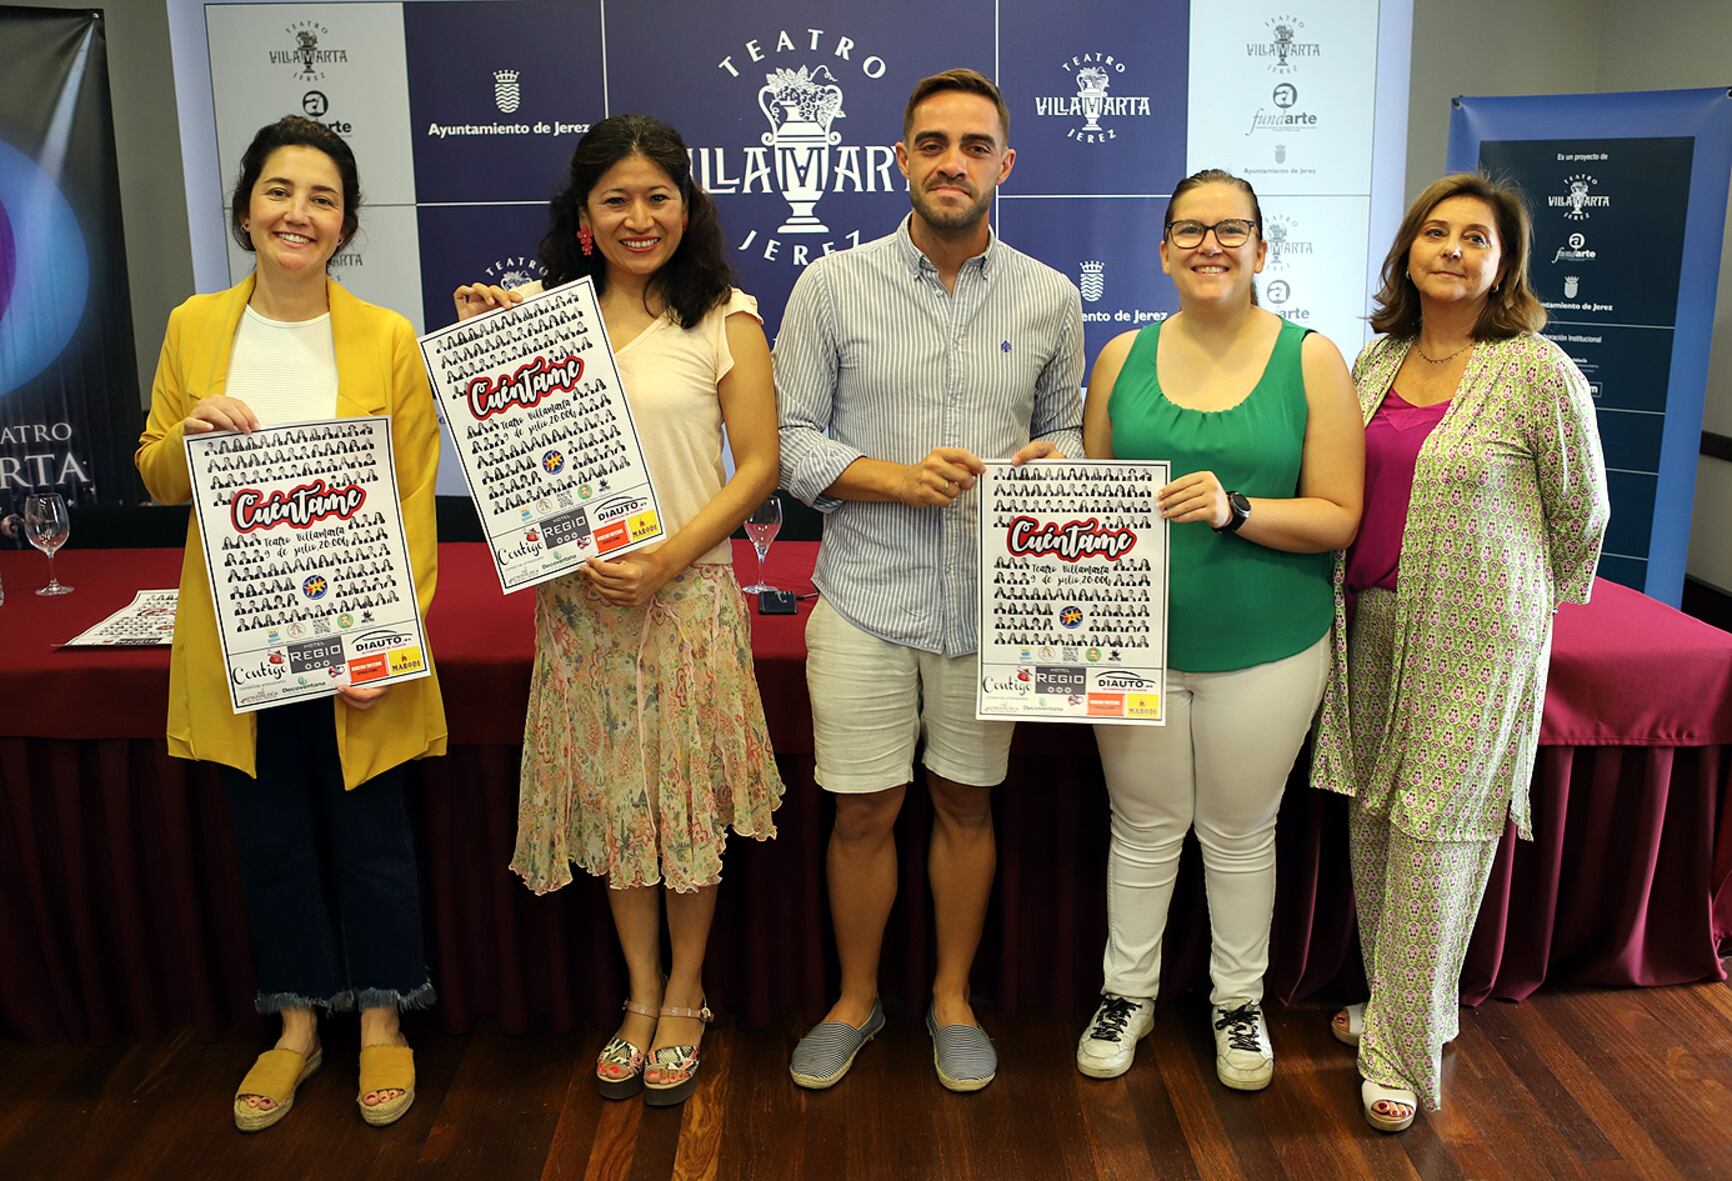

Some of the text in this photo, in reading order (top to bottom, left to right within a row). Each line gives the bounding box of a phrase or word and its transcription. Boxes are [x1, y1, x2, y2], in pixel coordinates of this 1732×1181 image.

[269, 49, 348, 64] VILLAMARTA
[718, 28, 886, 79] TEATRO
[1246, 43, 1320, 56] VILLAMARTA
[1061, 52, 1126, 73] TEATRO
[1035, 96, 1151, 116] VILLAMARTA
[328, 120, 352, 134] rte
[428, 121, 590, 139] Ayuntamiento de Jerez
[1245, 107, 1318, 136] fundarte
[1066, 128, 1117, 144] JEREZ
[1574, 153, 1600, 162] proyecto
[686, 144, 911, 194] LLAMAR
[333, 253, 364, 267] ARTA
[1279, 307, 1311, 320] arte
[1541, 301, 1614, 312] ntamiento de Jerez
[1081, 309, 1168, 324] ento de Jerez
[468, 357, 583, 420] Cuéntame
[500, 416, 524, 431] Teatro
[0, 422, 72, 445] ATRO
[513, 428, 524, 439] de
[0, 451, 91, 490] RTA
[232, 480, 365, 533] Cuéntame
[541, 517, 587, 538] REGIO
[263, 537, 291, 549] Teatro
[1008, 516, 1136, 561] Cuéntame
[277, 547, 288, 558] de
[497, 536, 544, 566] Contigo
[1032, 563, 1057, 574] Teatro
[290, 645, 341, 663] REGIO
[233, 661, 287, 686] Contigo
[1037, 673, 1085, 685] REGIO
[982, 675, 1032, 696] Contigo
